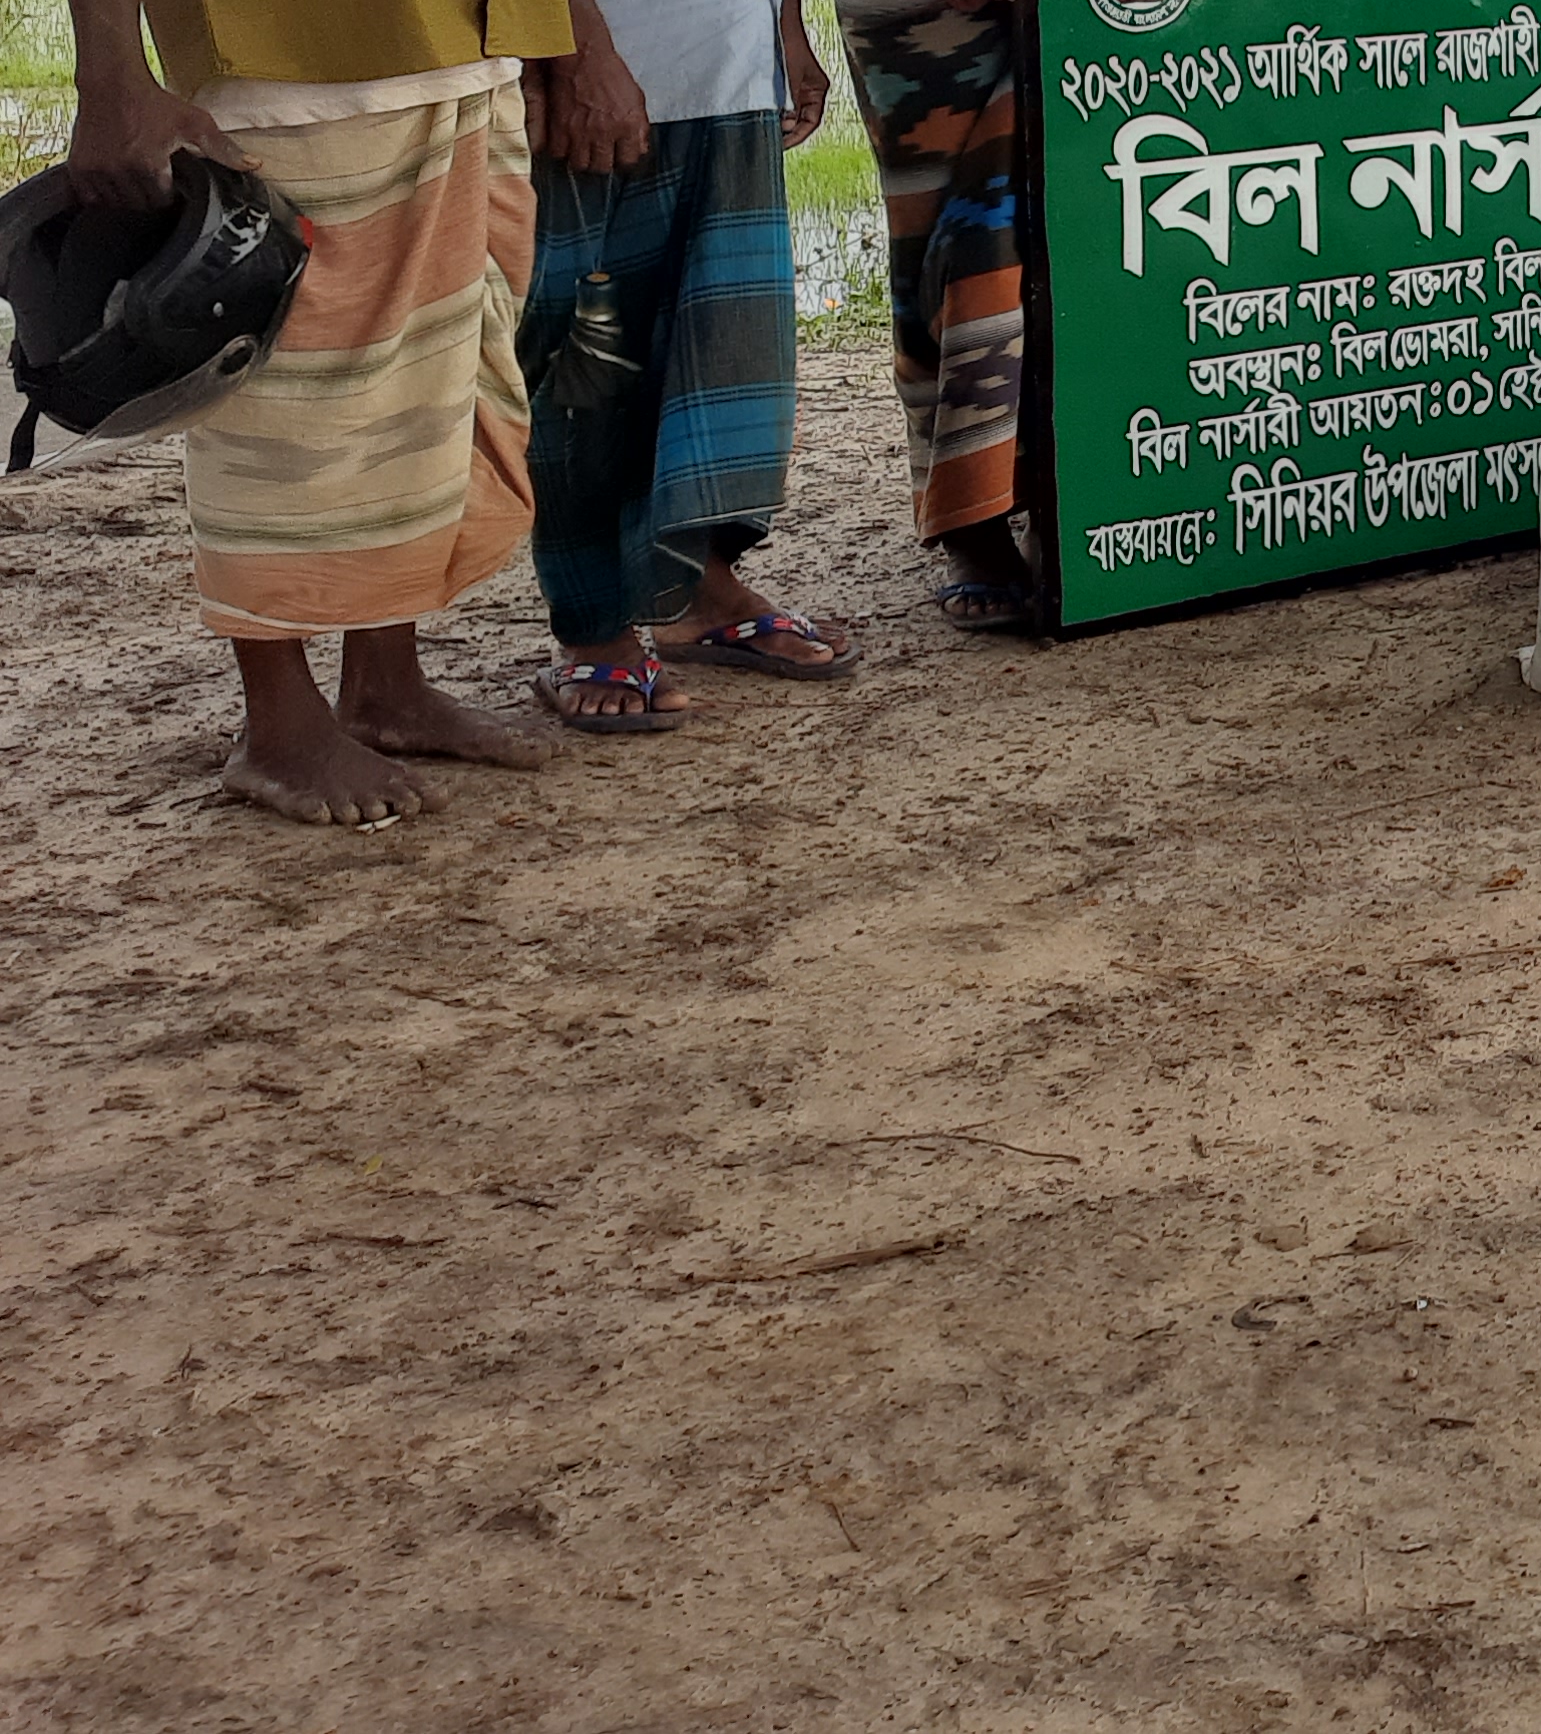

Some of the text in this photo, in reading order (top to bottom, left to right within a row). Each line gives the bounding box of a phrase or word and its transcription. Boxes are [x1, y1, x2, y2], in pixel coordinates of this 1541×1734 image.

[1060, 45, 1243, 122] ২০২০-২০২১
[1247, 23, 1347, 99] আর্থিক
[1354, 31, 1428, 90] সালে
[1435, 4, 1541, 83] রাজশাহী
[1102, 113, 1325, 278] বিল
[1184, 277, 1290, 344] বিলের
[1388, 257, 1487, 309] রক্তদহ
[1331, 321, 1389, 378] বিল
[1390, 315, 1490, 371] ভোমরা,
[1125, 407, 1190, 477] বিল
[1197, 391, 1302, 463] নার্সারী
[1447, 371, 1494, 416] ০১
[1227, 456, 1358, 556] সিনিয়র
[1363, 444, 1479, 528] উপজেলা
